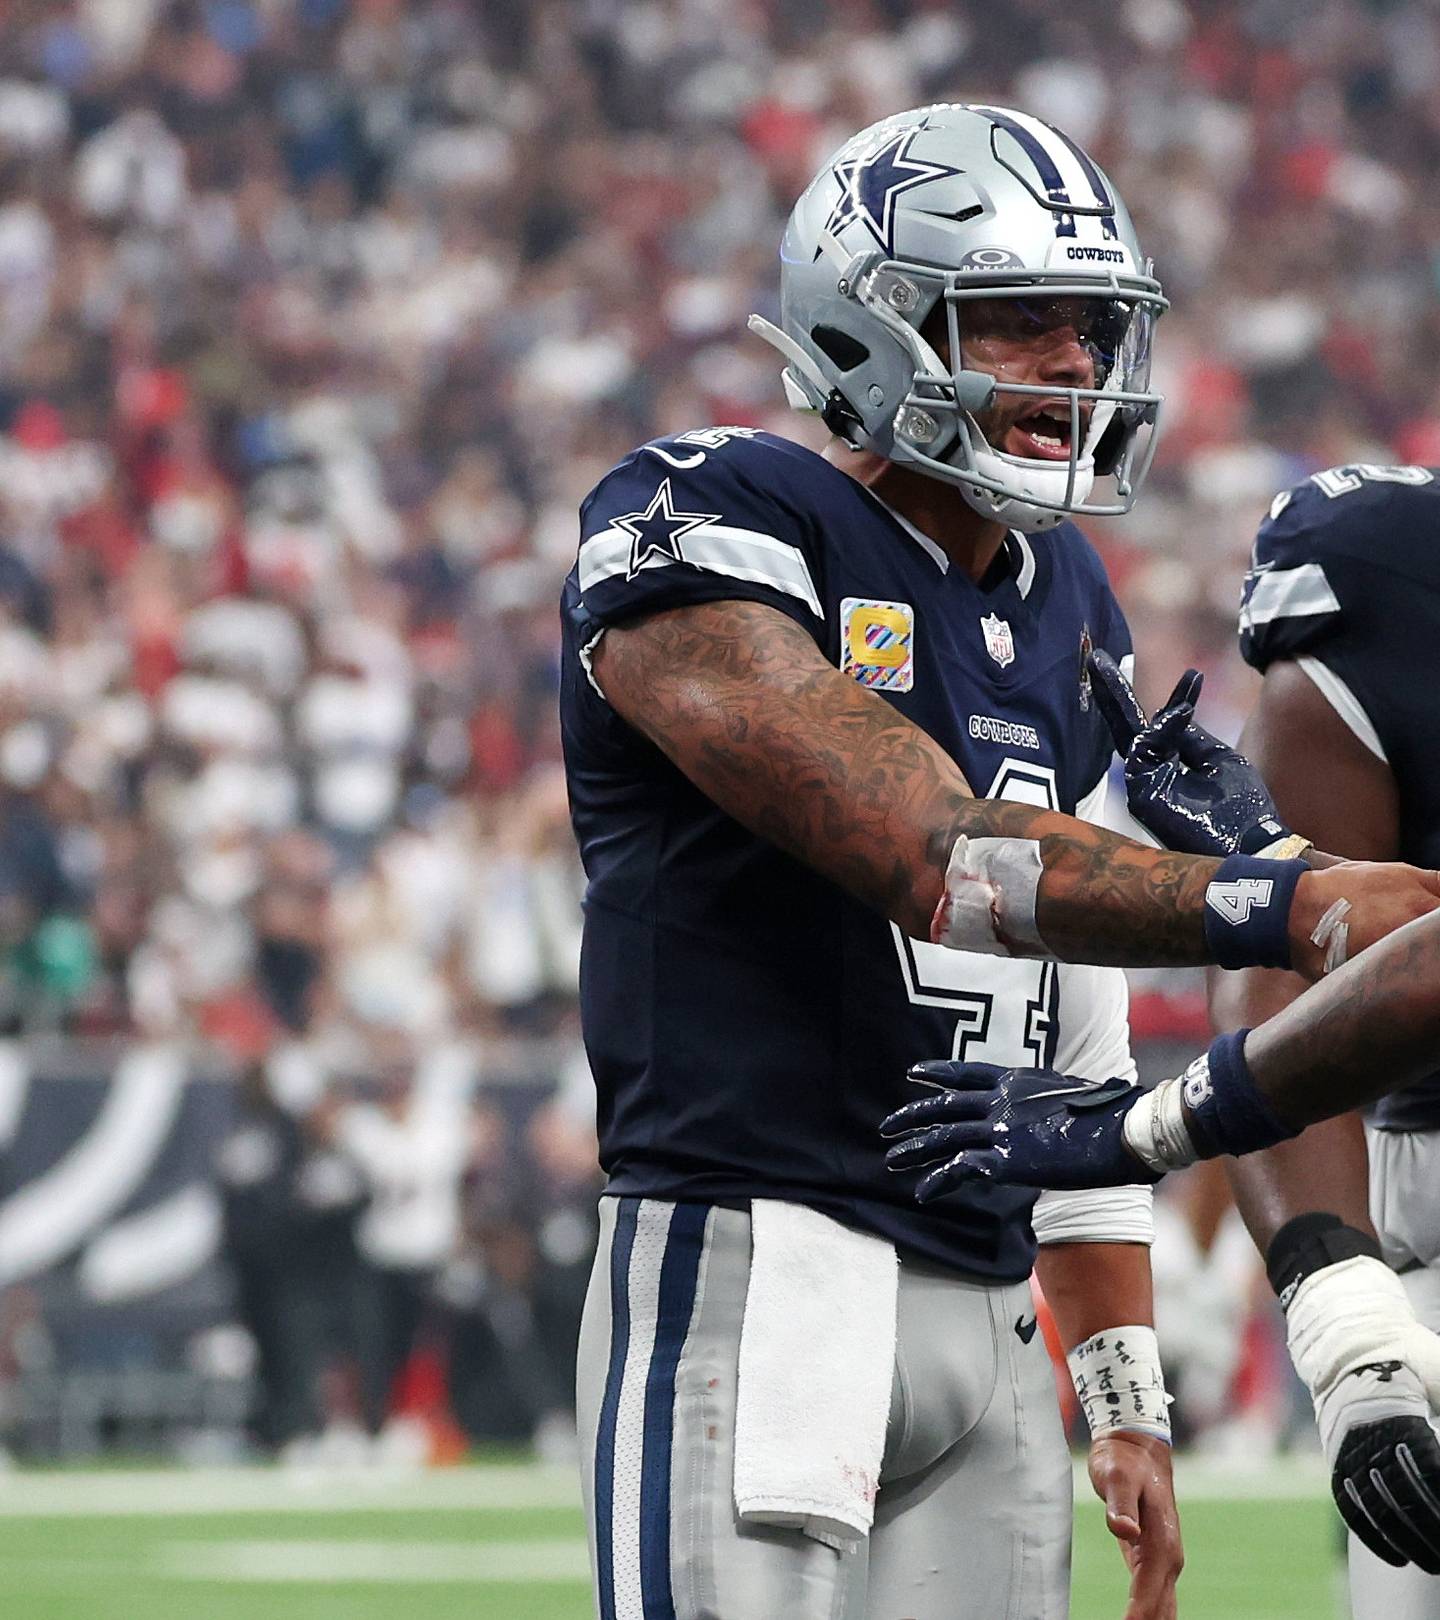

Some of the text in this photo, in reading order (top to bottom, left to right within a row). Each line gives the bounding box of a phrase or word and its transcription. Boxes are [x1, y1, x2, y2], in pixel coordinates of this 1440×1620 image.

[1067, 247, 1125, 263] COWBOYS
[849, 606, 911, 668] C
[991, 638, 1013, 657] NFL
[968, 714, 1040, 750] COWBOYS
[1205, 878, 1274, 926] 4
